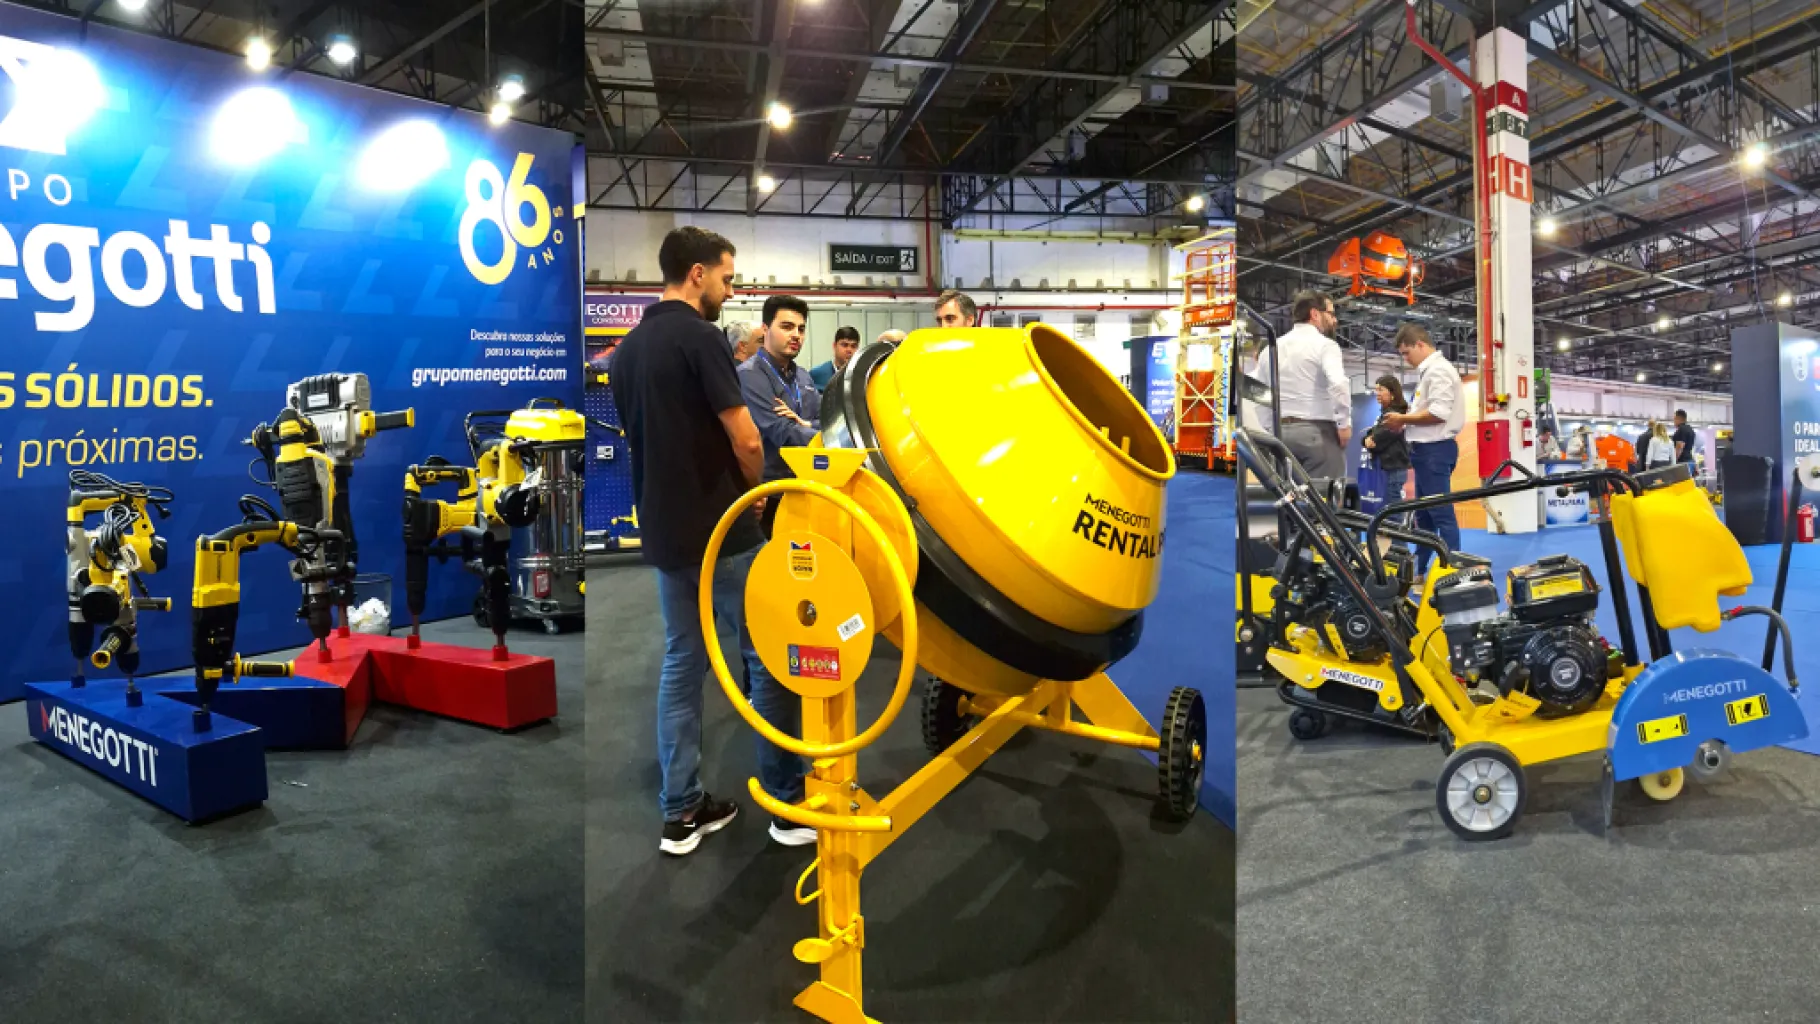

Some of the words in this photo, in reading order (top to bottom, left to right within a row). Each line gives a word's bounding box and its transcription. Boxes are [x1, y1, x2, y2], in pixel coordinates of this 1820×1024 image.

[1512, 91, 1522, 107] A
[458, 152, 552, 285] 86
[527, 206, 564, 269] ANOS
[834, 250, 868, 264] SAÍDA
[876, 256, 895, 264] EXIT
[592, 316, 642, 326] CONSTRUÇÃ
[470, 329, 507, 341] Descubra
[509, 332, 534, 342] nossas
[535, 331, 566, 343] soluções
[485, 348, 503, 358] para
[511, 348, 525, 356] seu
[526, 346, 555, 359] negócio
[25, 362, 214, 409] SÓLIDOS.
[412, 364, 567, 387] grupomenegotti.com
[1794, 420, 1801, 435] O
[17, 428, 204, 479] próximas.
[1084, 492, 1151, 529] MENEGOTTI
[1072, 509, 1156, 559] RENTAL
[1321, 667, 1384, 690] MENEGOTTI
[1663, 679, 1748, 704] MENEGOTTI
[40, 700, 156, 787] MENEGOTTI
